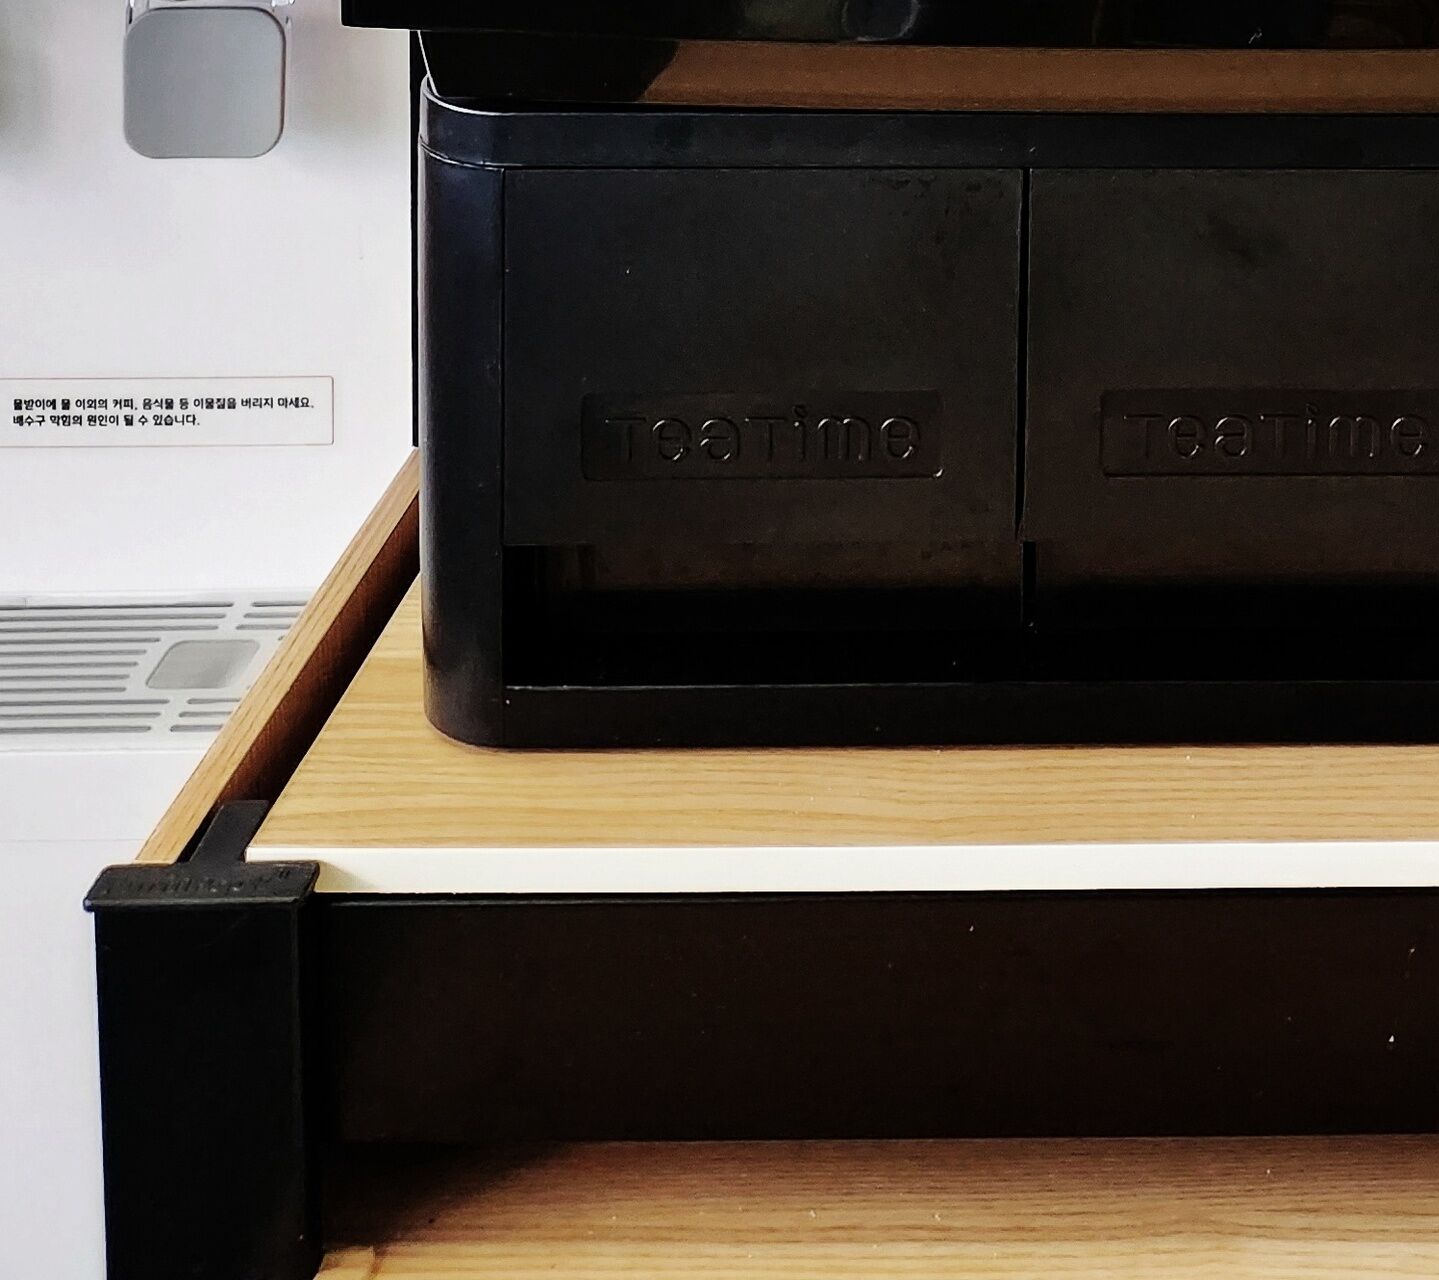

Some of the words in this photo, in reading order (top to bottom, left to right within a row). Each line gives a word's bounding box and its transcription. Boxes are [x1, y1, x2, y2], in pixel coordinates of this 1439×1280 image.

[74, 398, 108, 411] 이외의
[240, 397, 274, 409] 버리지
[12, 414, 46, 427] 배수구
[86, 414, 119, 427] 원인이
[137, 414, 149, 427] 수
